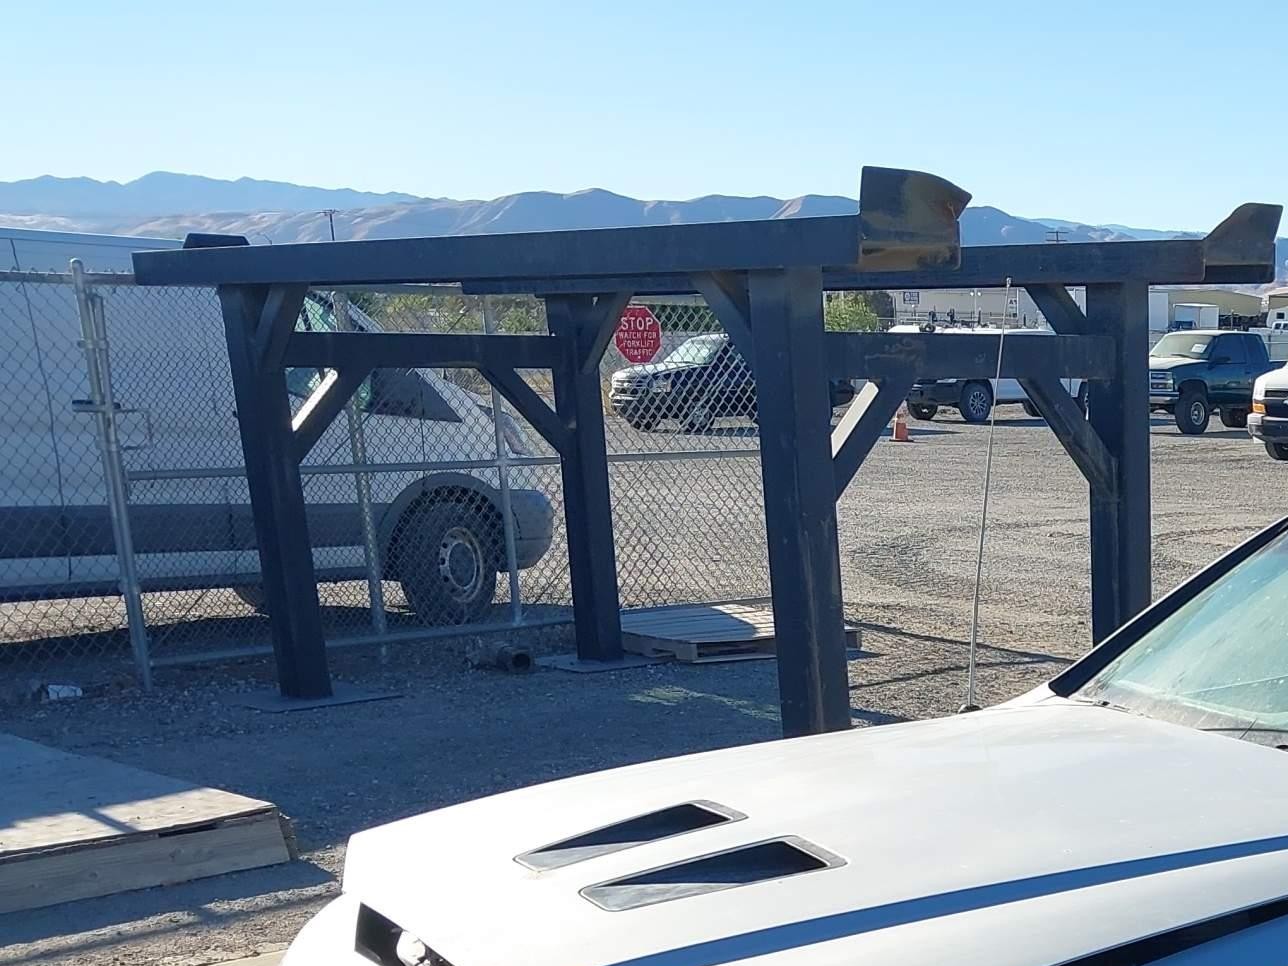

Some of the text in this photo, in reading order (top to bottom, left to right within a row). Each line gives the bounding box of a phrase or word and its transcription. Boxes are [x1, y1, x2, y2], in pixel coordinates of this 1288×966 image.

[620, 316, 654, 331] STOP
[618, 331, 642, 339] WATCH
[623, 340, 654, 348] FORKLIFT
[625, 348, 653, 356] TRAFFIC
